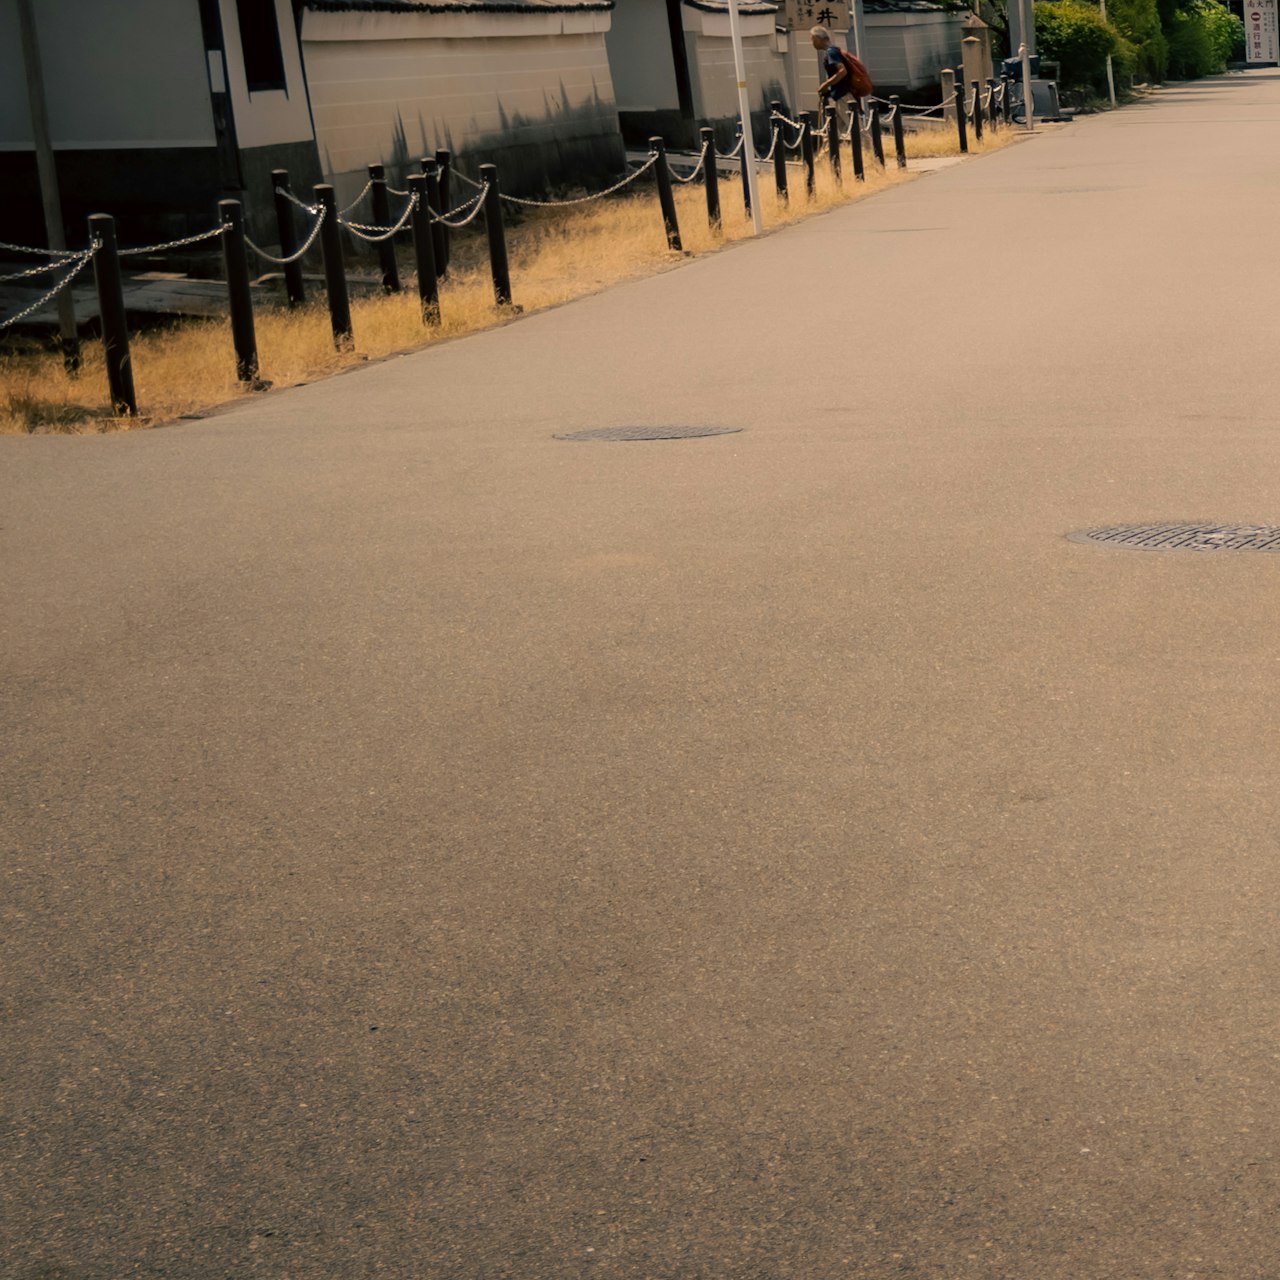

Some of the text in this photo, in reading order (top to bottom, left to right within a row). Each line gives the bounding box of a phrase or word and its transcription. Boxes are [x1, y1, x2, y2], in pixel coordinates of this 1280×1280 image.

[1247, 0, 1274, 9] 南大門
[1252, 23, 1262, 59] 通行禁止
